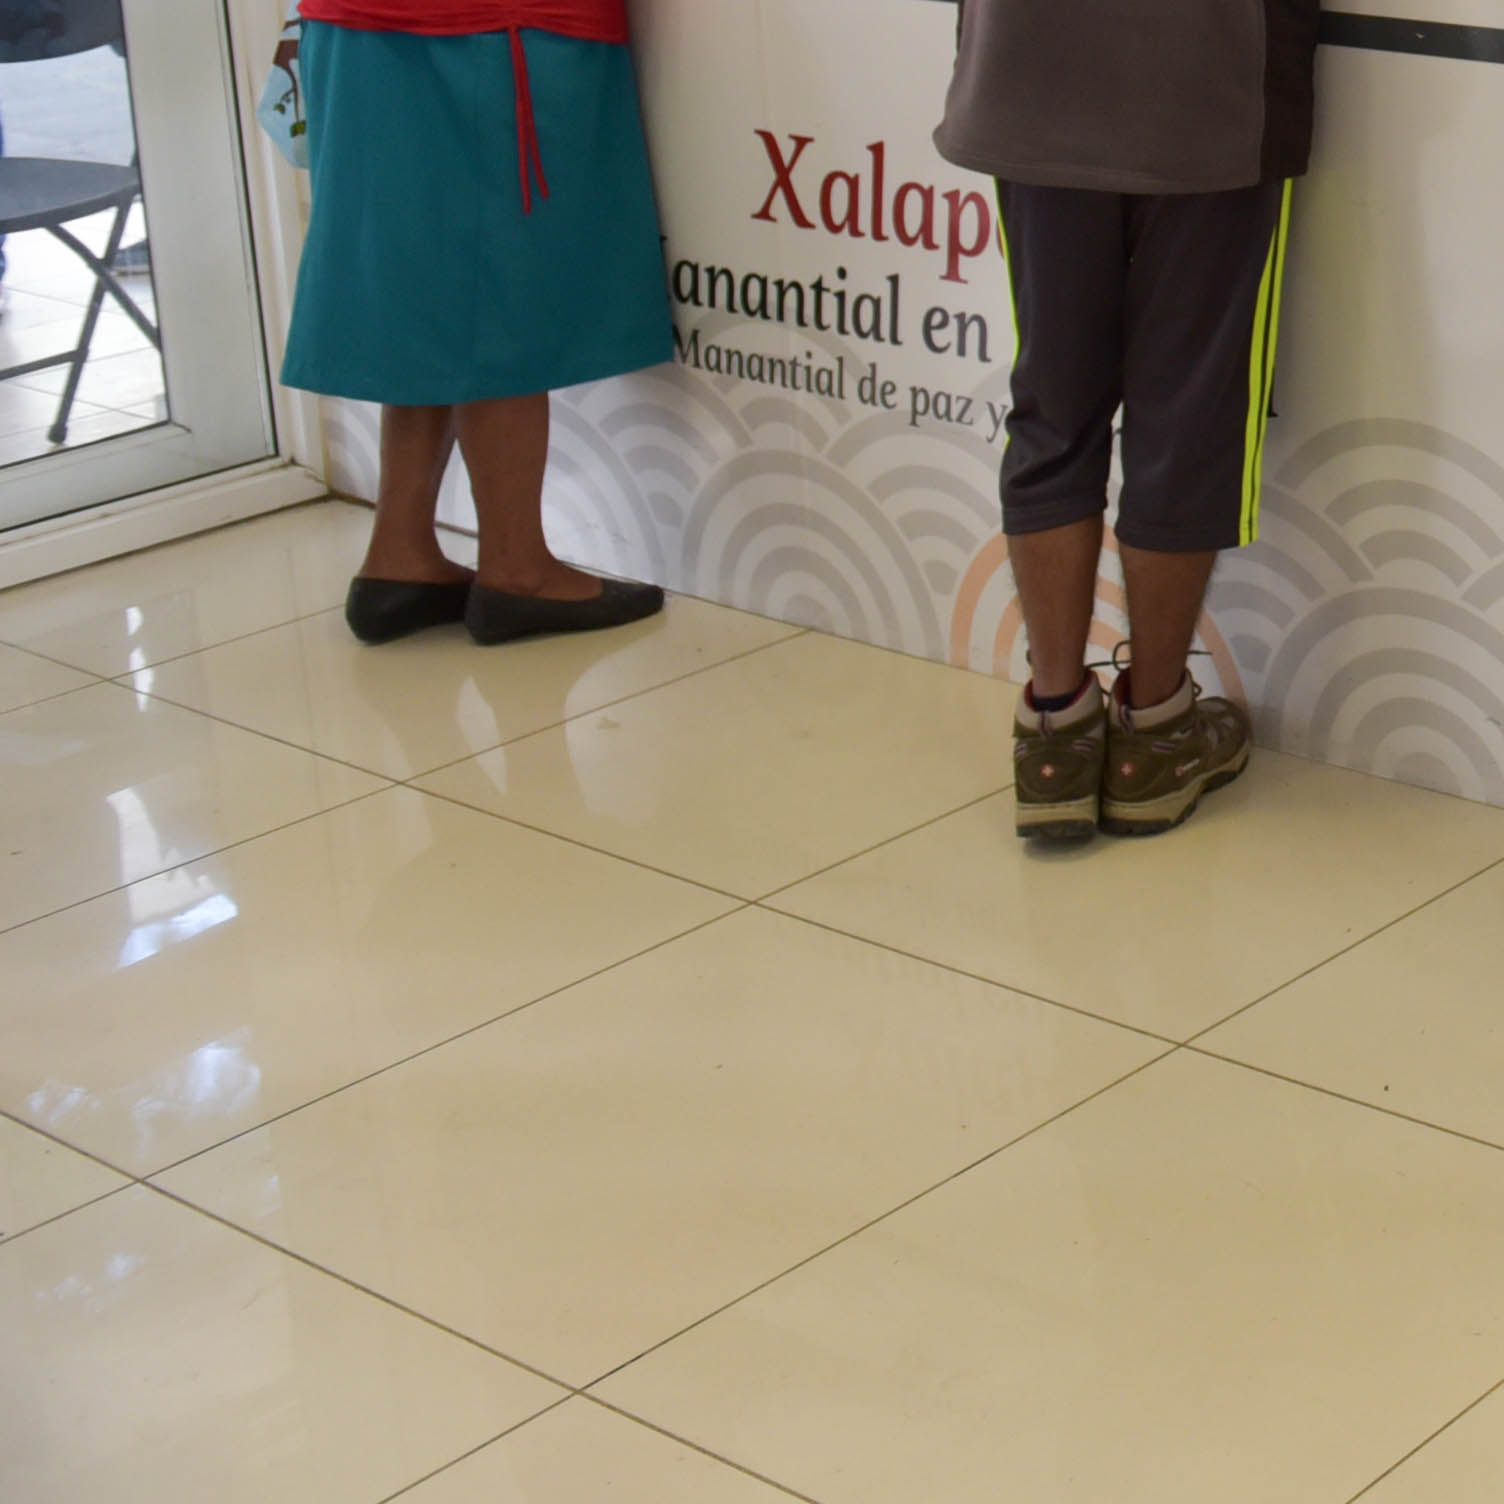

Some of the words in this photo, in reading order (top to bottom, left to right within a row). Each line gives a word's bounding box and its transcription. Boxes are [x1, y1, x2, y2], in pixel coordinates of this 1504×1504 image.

[750, 129, 1005, 284] Xalap
[670, 258, 903, 346] anantial
[922, 306, 992, 363] en
[671, 325, 846, 401] Manantial
[857, 362, 897, 409] de
[909, 385, 974, 427] paz
[985, 400, 1009, 444] y
